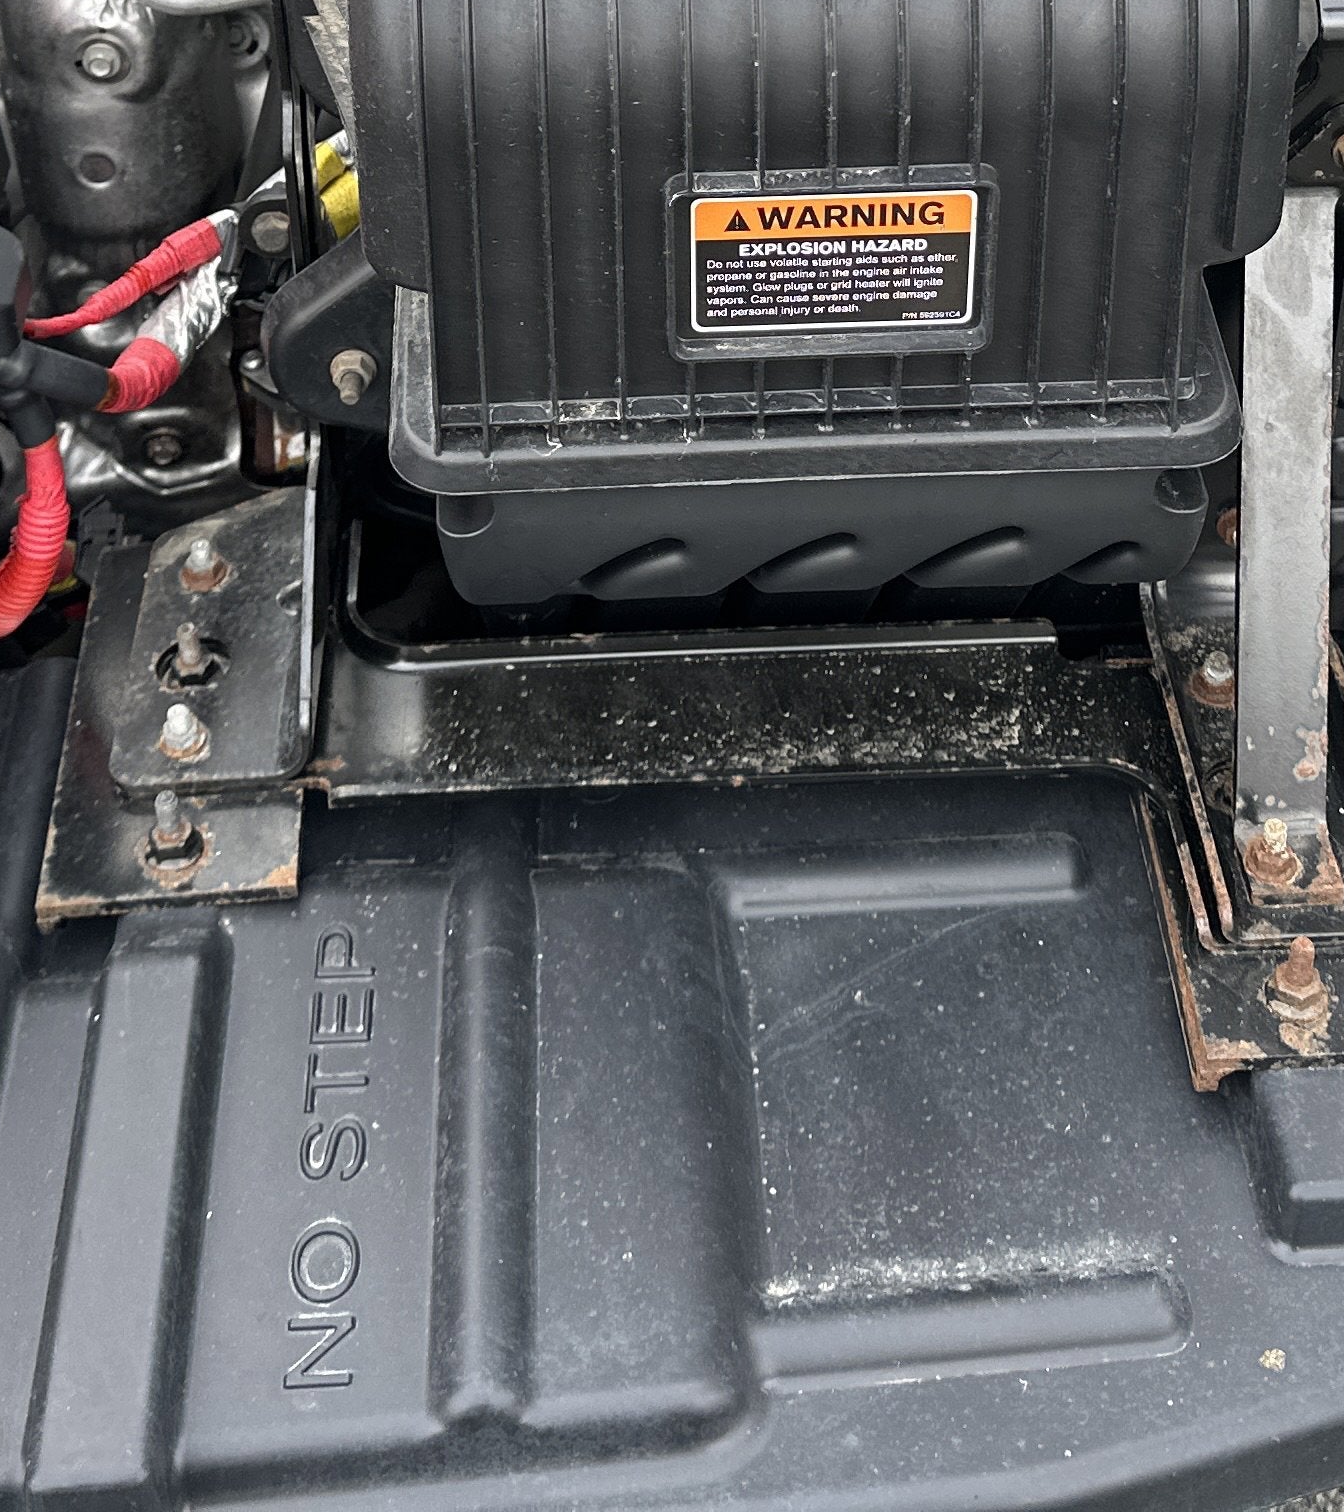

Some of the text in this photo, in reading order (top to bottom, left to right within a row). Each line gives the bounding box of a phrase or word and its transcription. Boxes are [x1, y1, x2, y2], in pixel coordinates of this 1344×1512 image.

[757, 201, 944, 230] WARNING
[739, 238, 928, 257] EXPLOSION HAZARD
[706, 260, 723, 269] Do
[726, 259, 744, 269] not
[747, 260, 767, 268] use
[770, 258, 809, 267] volatile
[812, 257, 852, 267] starting
[855, 255, 878, 264] aids
[881, 254, 908, 263] such
[911, 255, 925, 263] as
[706, 266, 944, 283] propane or gasoline in the engine air intake
[706, 277, 944, 295] system. Glow plugs or grid heater will ignite
[706, 290, 938, 307] vapors. Can cause severe engine damage
[706, 303, 861, 318] and personal injury or death.
[284, 923, 378, 1391] NO STEP
